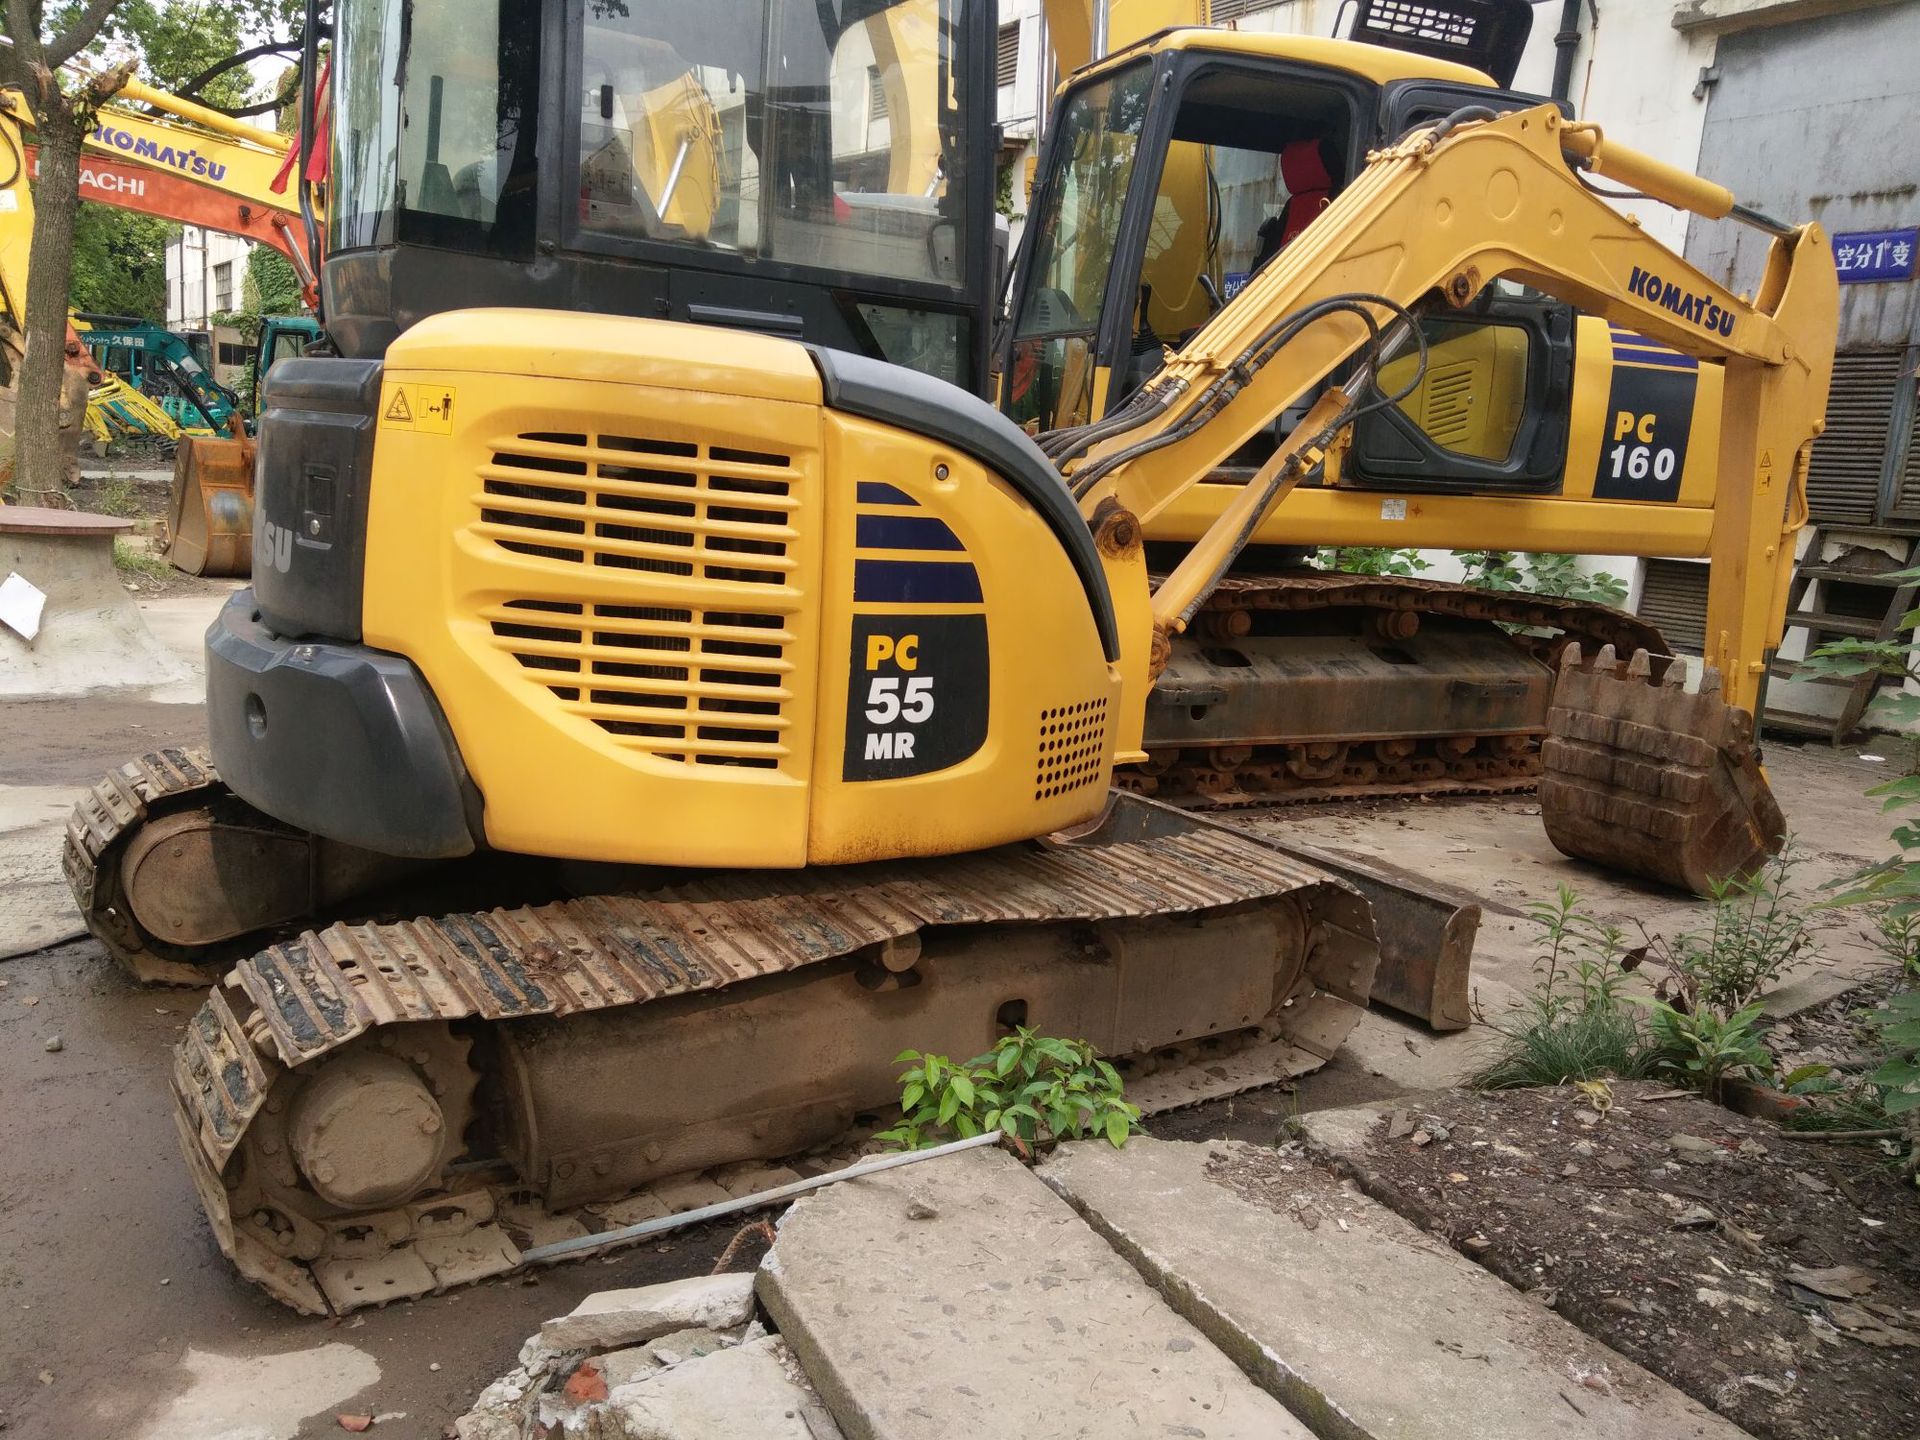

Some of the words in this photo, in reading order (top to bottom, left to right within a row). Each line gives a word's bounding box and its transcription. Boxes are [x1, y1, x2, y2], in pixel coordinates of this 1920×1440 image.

[93, 124, 226, 181] KOMATSU
[1628, 266, 1736, 337] KOMATSU
[112, 335, 144, 347] 久保田
[1614, 411, 1656, 443] PC
[1611, 445, 1675, 481] 160
[256, 508, 293, 573] SU
[866, 634, 919, 671] PC
[865, 677, 935, 725] 55
[864, 732, 915, 760] MR
